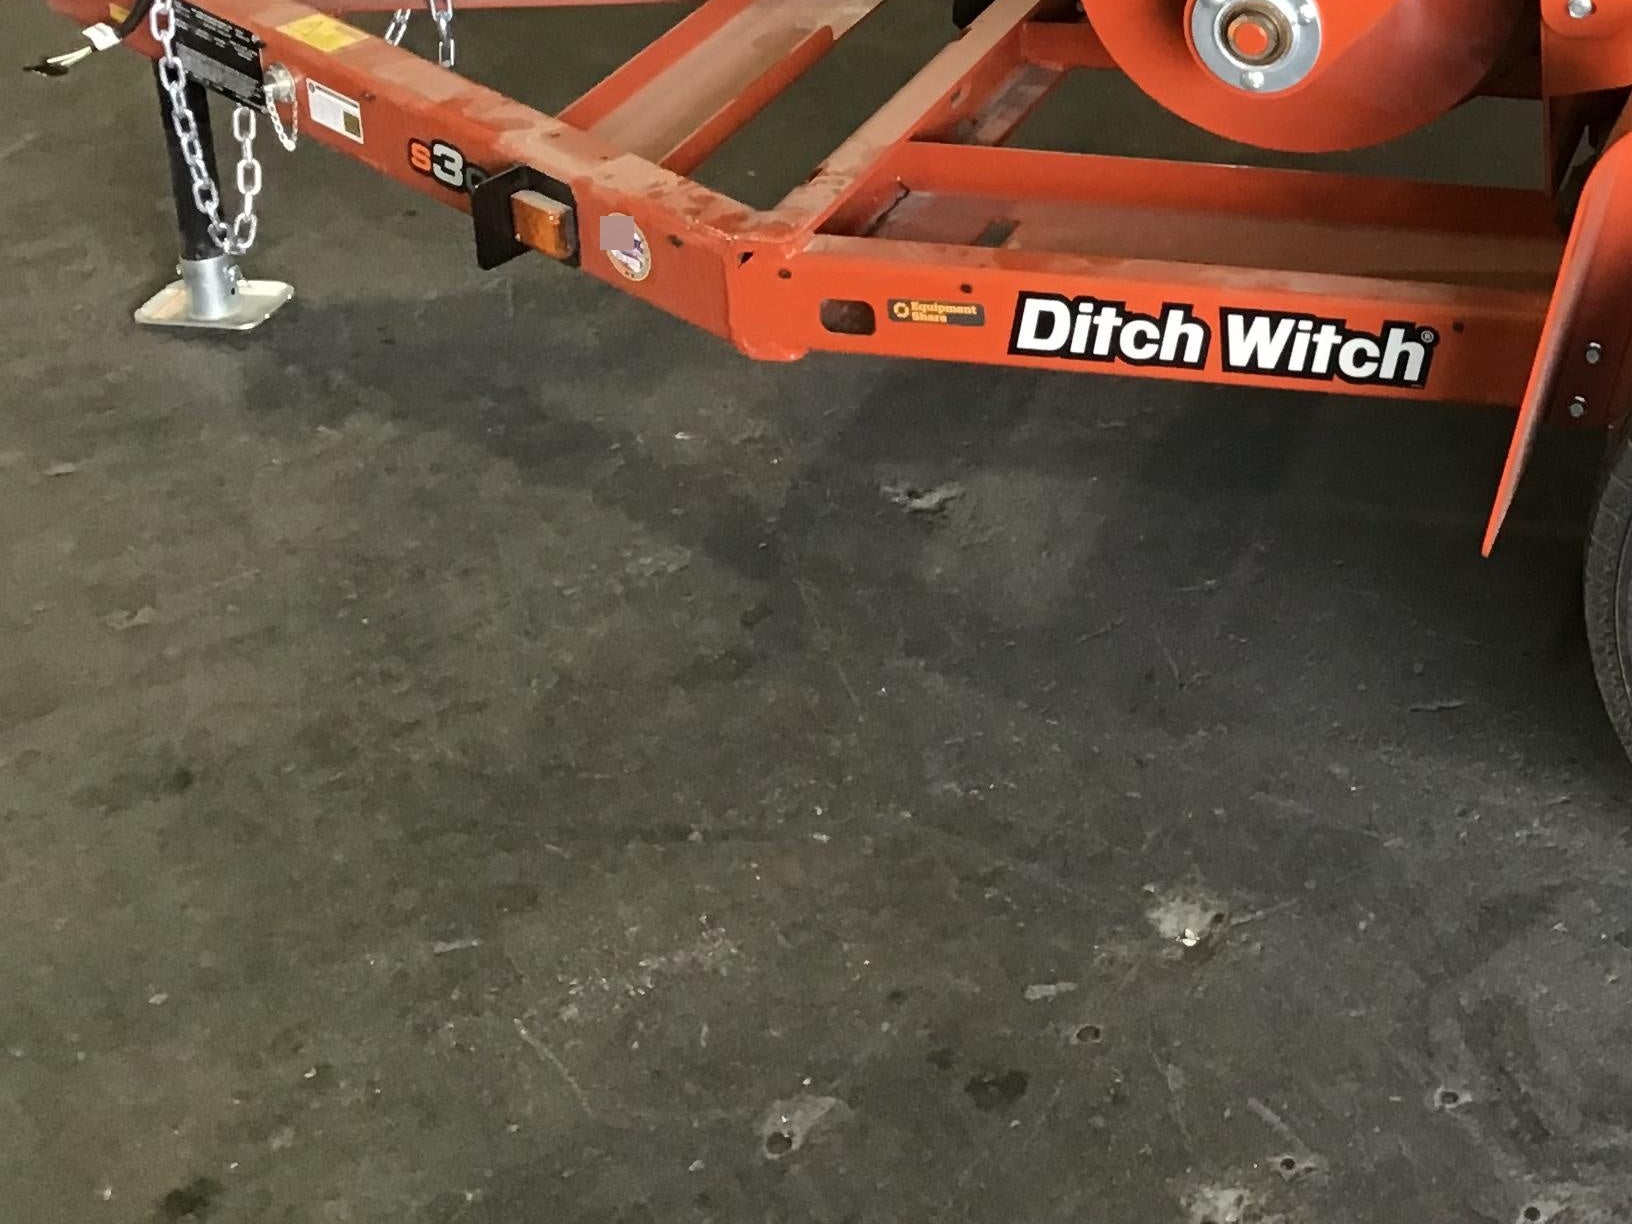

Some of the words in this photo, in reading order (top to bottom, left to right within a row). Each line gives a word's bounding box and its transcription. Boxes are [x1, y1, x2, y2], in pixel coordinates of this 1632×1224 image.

[911, 301, 977, 315] Equipment
[911, 311, 948, 323] Share
[1015, 298, 1202, 364] Ditch
